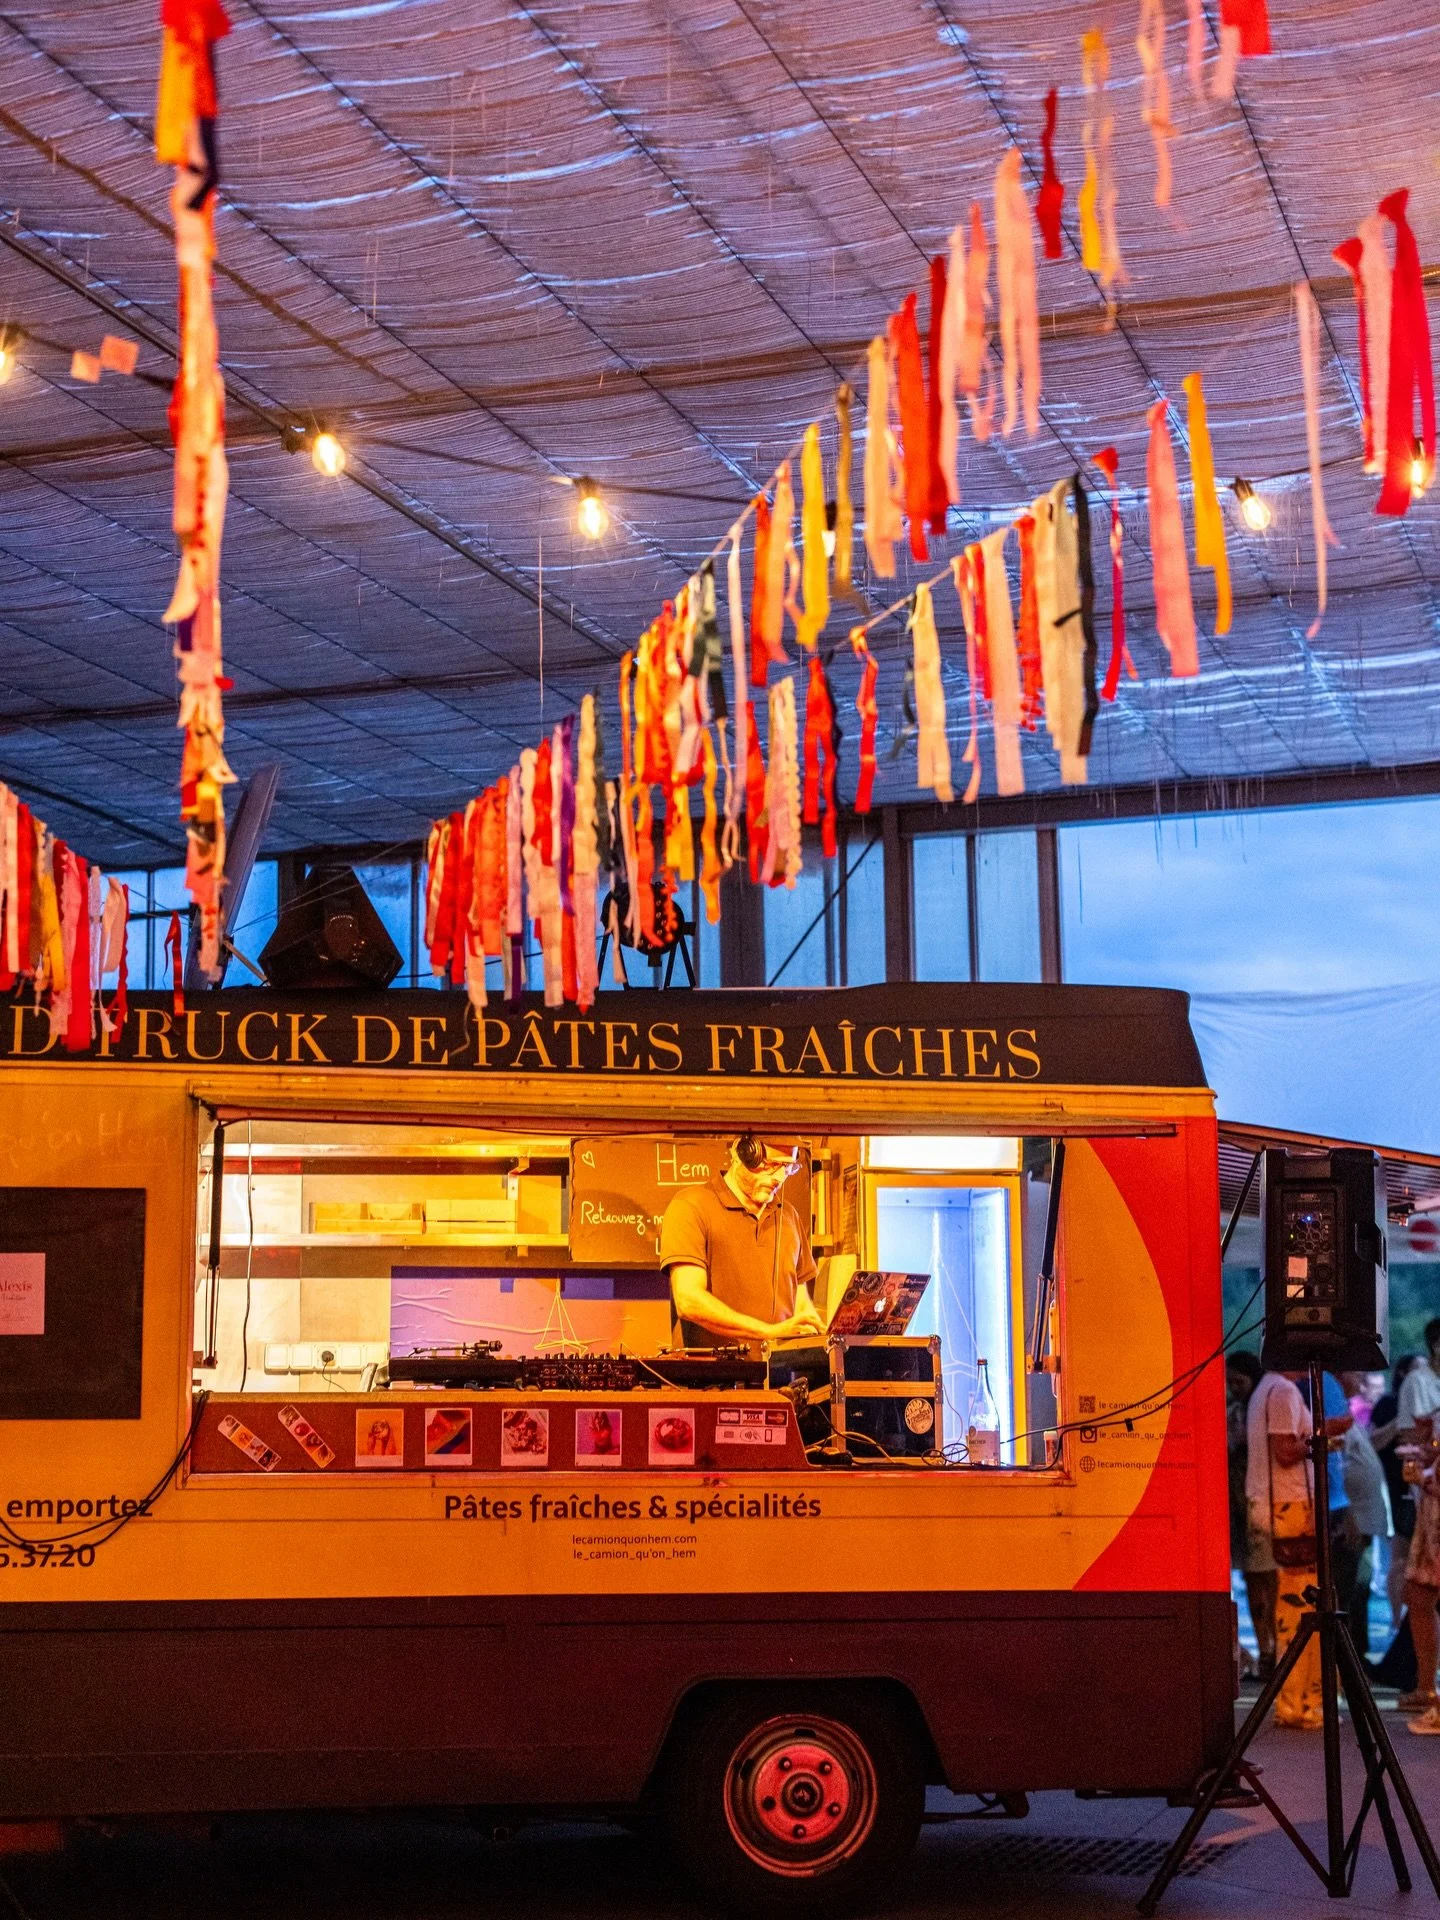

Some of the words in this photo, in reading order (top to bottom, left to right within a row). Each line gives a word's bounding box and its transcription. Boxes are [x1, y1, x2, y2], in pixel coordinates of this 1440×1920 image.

[94, 1007, 332, 1063] TRUCK
[352, 1015, 448, 1066] DE
[472, 1010, 683, 1072] PÂTES
[705, 1019, 1041, 1079] FRAÎCHES
[656, 1142, 710, 1182] Hem
[445, 1494, 523, 1520] Pâtes
[530, 1493, 642, 1524] fraîches
[648, 1495, 668, 1519] &
[675, 1492, 822, 1524] spécialités
[572, 1535, 698, 1547] lecamionquonhem.com
[573, 1548, 696, 1561] le_camion_qu'on_hem
